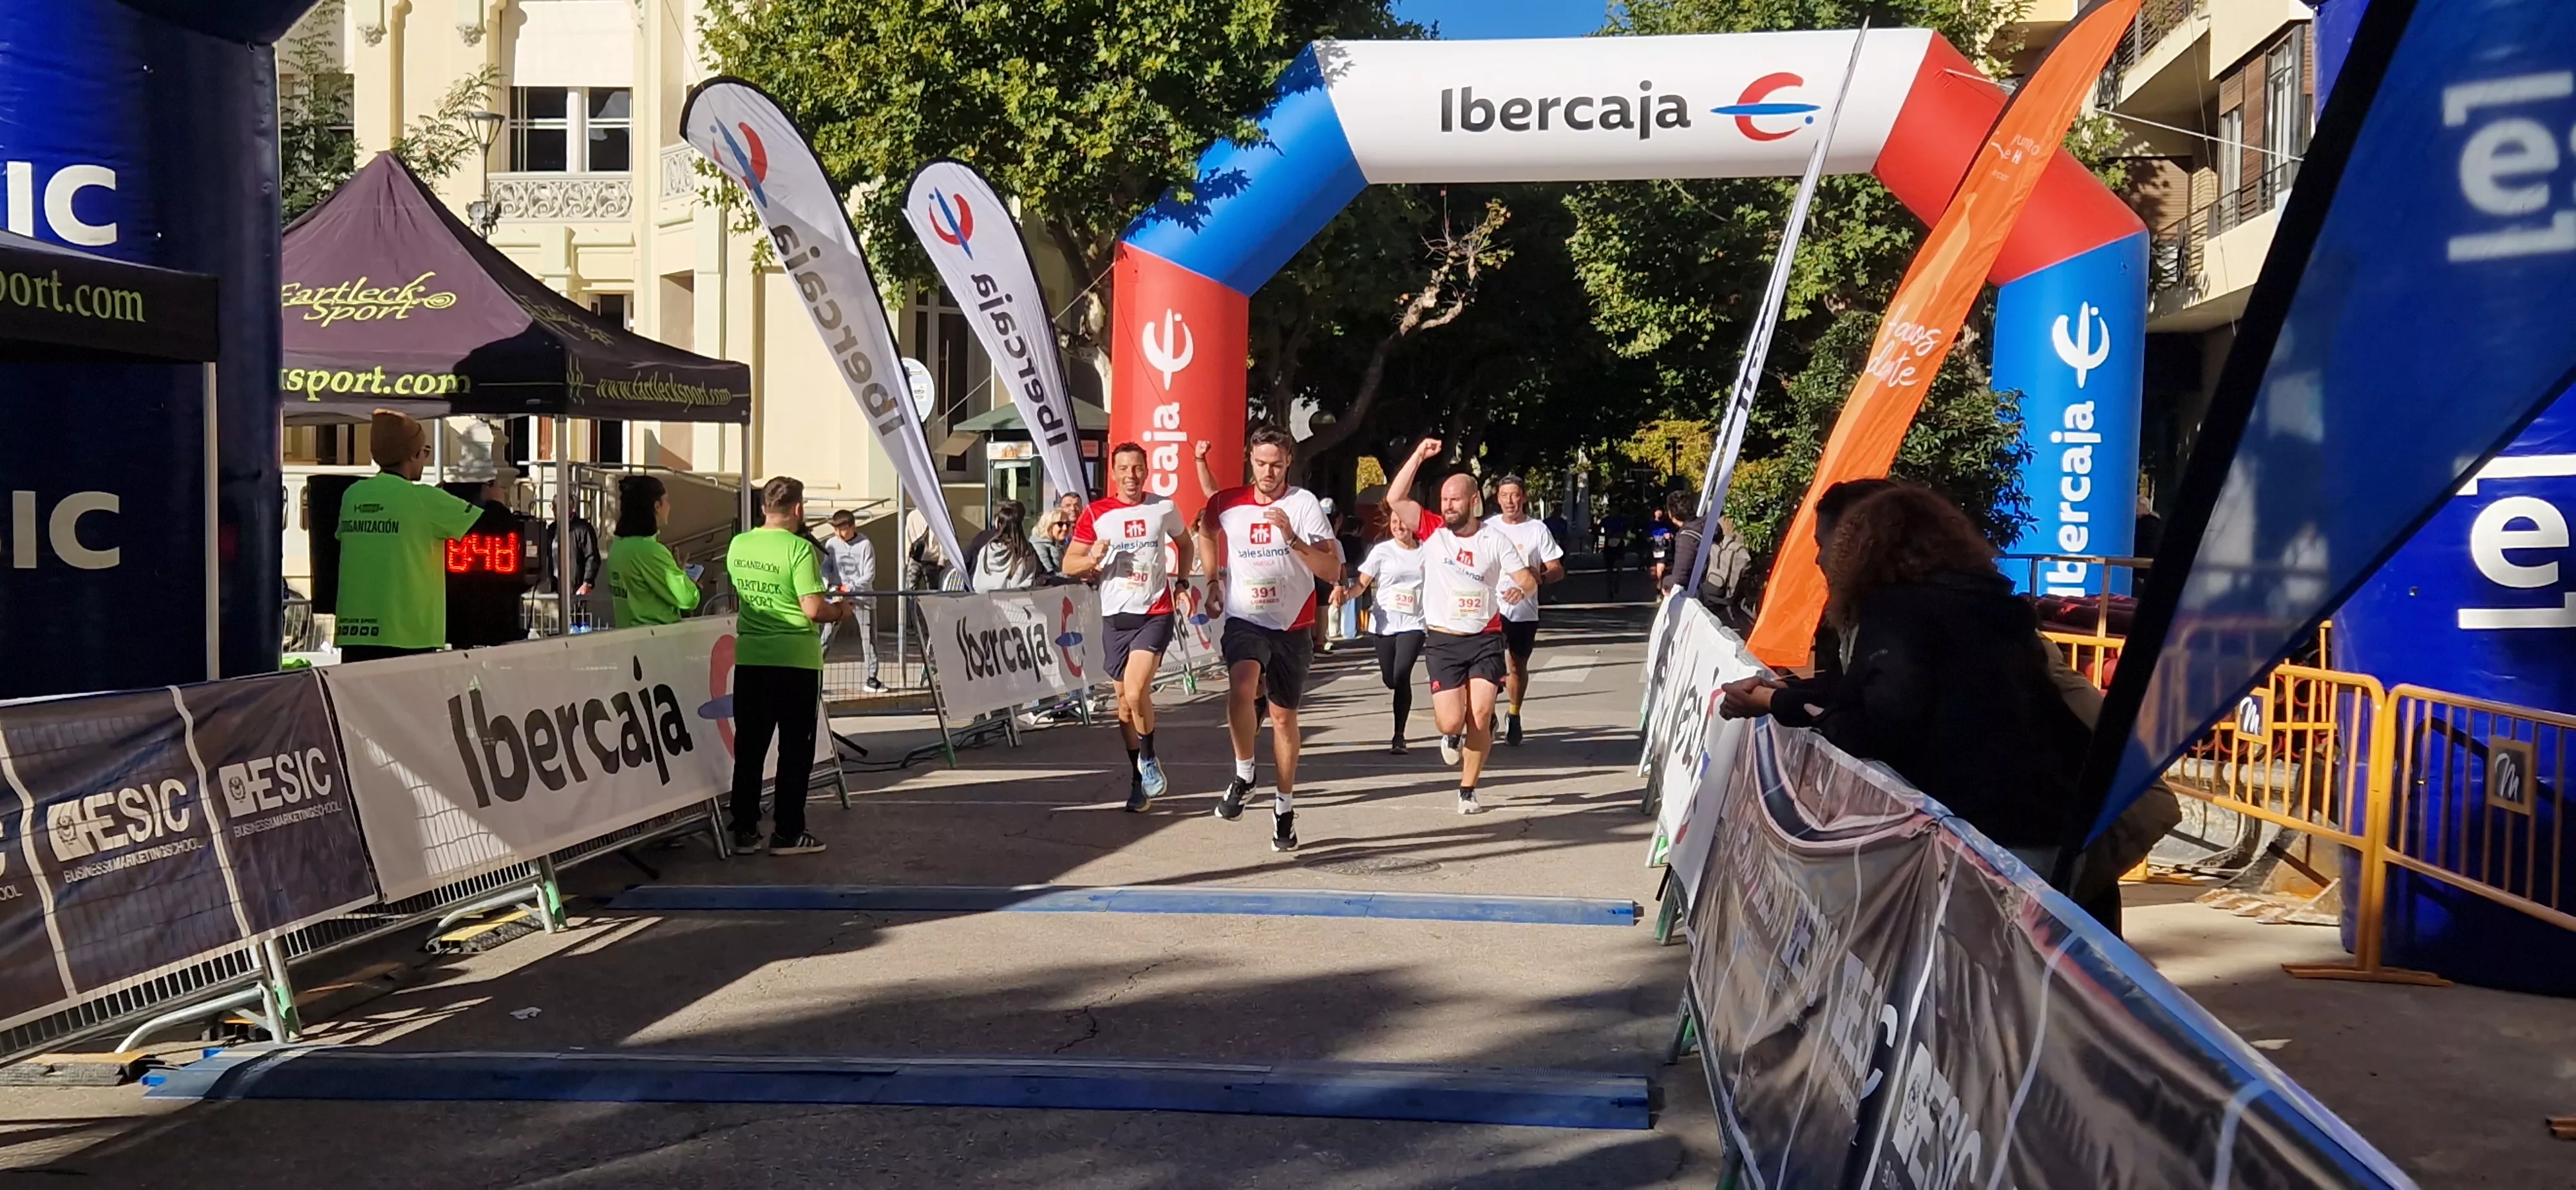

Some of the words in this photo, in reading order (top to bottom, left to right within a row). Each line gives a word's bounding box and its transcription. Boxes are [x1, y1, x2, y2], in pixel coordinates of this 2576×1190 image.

[1441, 80, 1692, 140] Ibercaja
[281, 271, 437, 306] Fartleck
[303, 298, 416, 328] Sport
[596, 370, 732, 413] www.fartlecksport.com
[12, 490, 120, 569] IC
[341, 518, 399, 534] GANIZACIÓN
[2047, 401, 2102, 598] Ibercaja
[1251, 587, 1276, 598] 391
[1459, 598, 1481, 608] 392
[956, 605, 1053, 682] Ibercaja
[448, 655, 694, 808] Ibercaja
[248, 747, 331, 811] ESIC
[81, 779, 190, 852] ESIC
